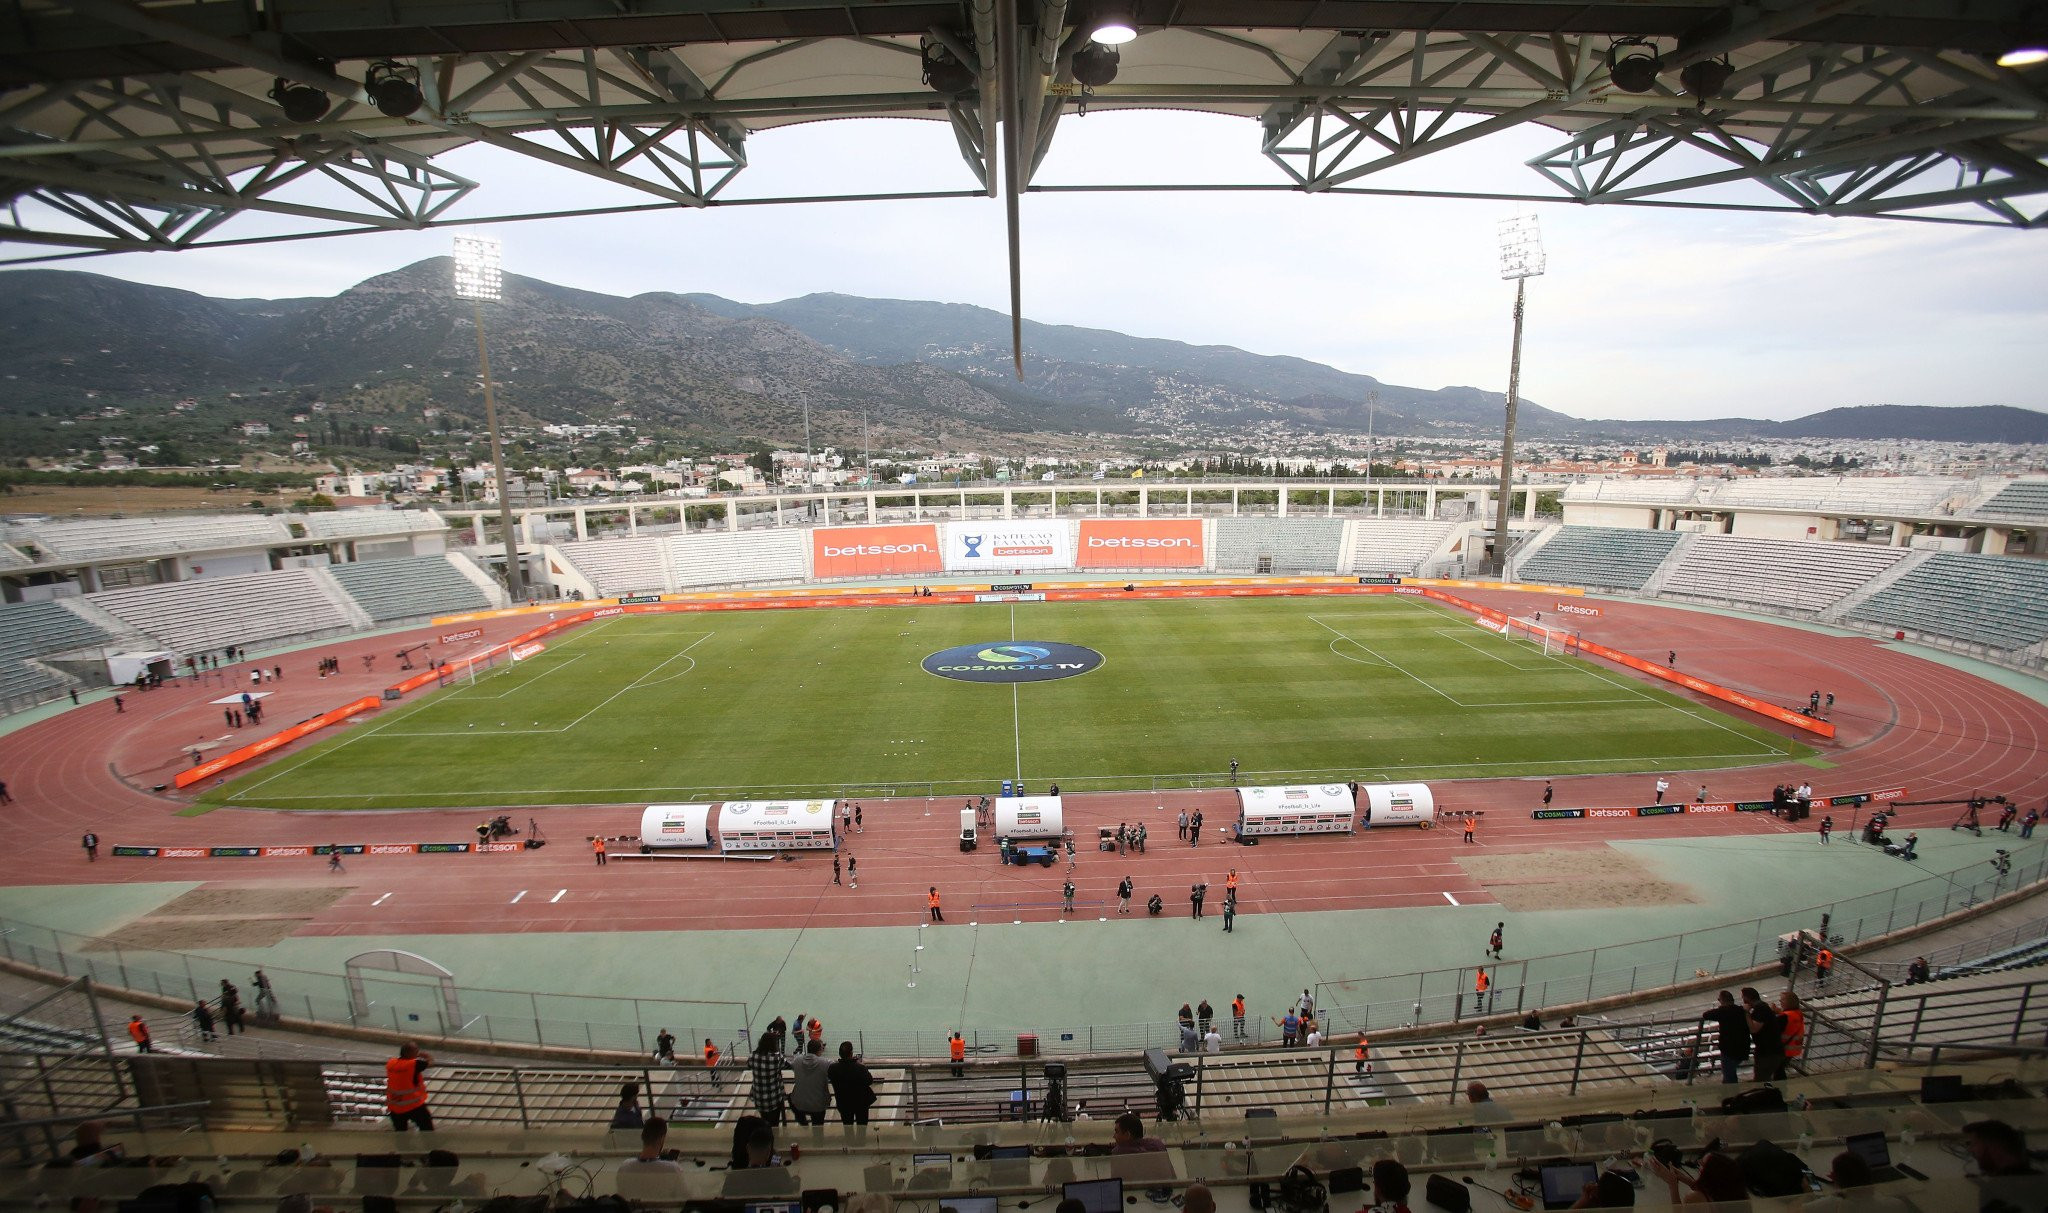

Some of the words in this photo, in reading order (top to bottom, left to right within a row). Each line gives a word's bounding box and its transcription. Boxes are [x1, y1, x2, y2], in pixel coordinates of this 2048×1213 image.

[1088, 536, 1191, 548] betsson
[823, 543, 928, 557] betsson
[997, 547, 1049, 555] betsson
[1393, 586, 1424, 595] betsson
[593, 607, 624, 617] betsson
[1557, 602, 1599, 616] betsson
[442, 629, 480, 644] betsson
[1873, 790, 1903, 801] betsson
[1589, 808, 1631, 817] betsson
[1646, 807, 1673, 815] COSMOTE
[1689, 804, 1728, 813] betsson
[164, 848, 205, 858] betsson
[267, 847, 308, 857] betsson
[369, 844, 412, 855] betsson
